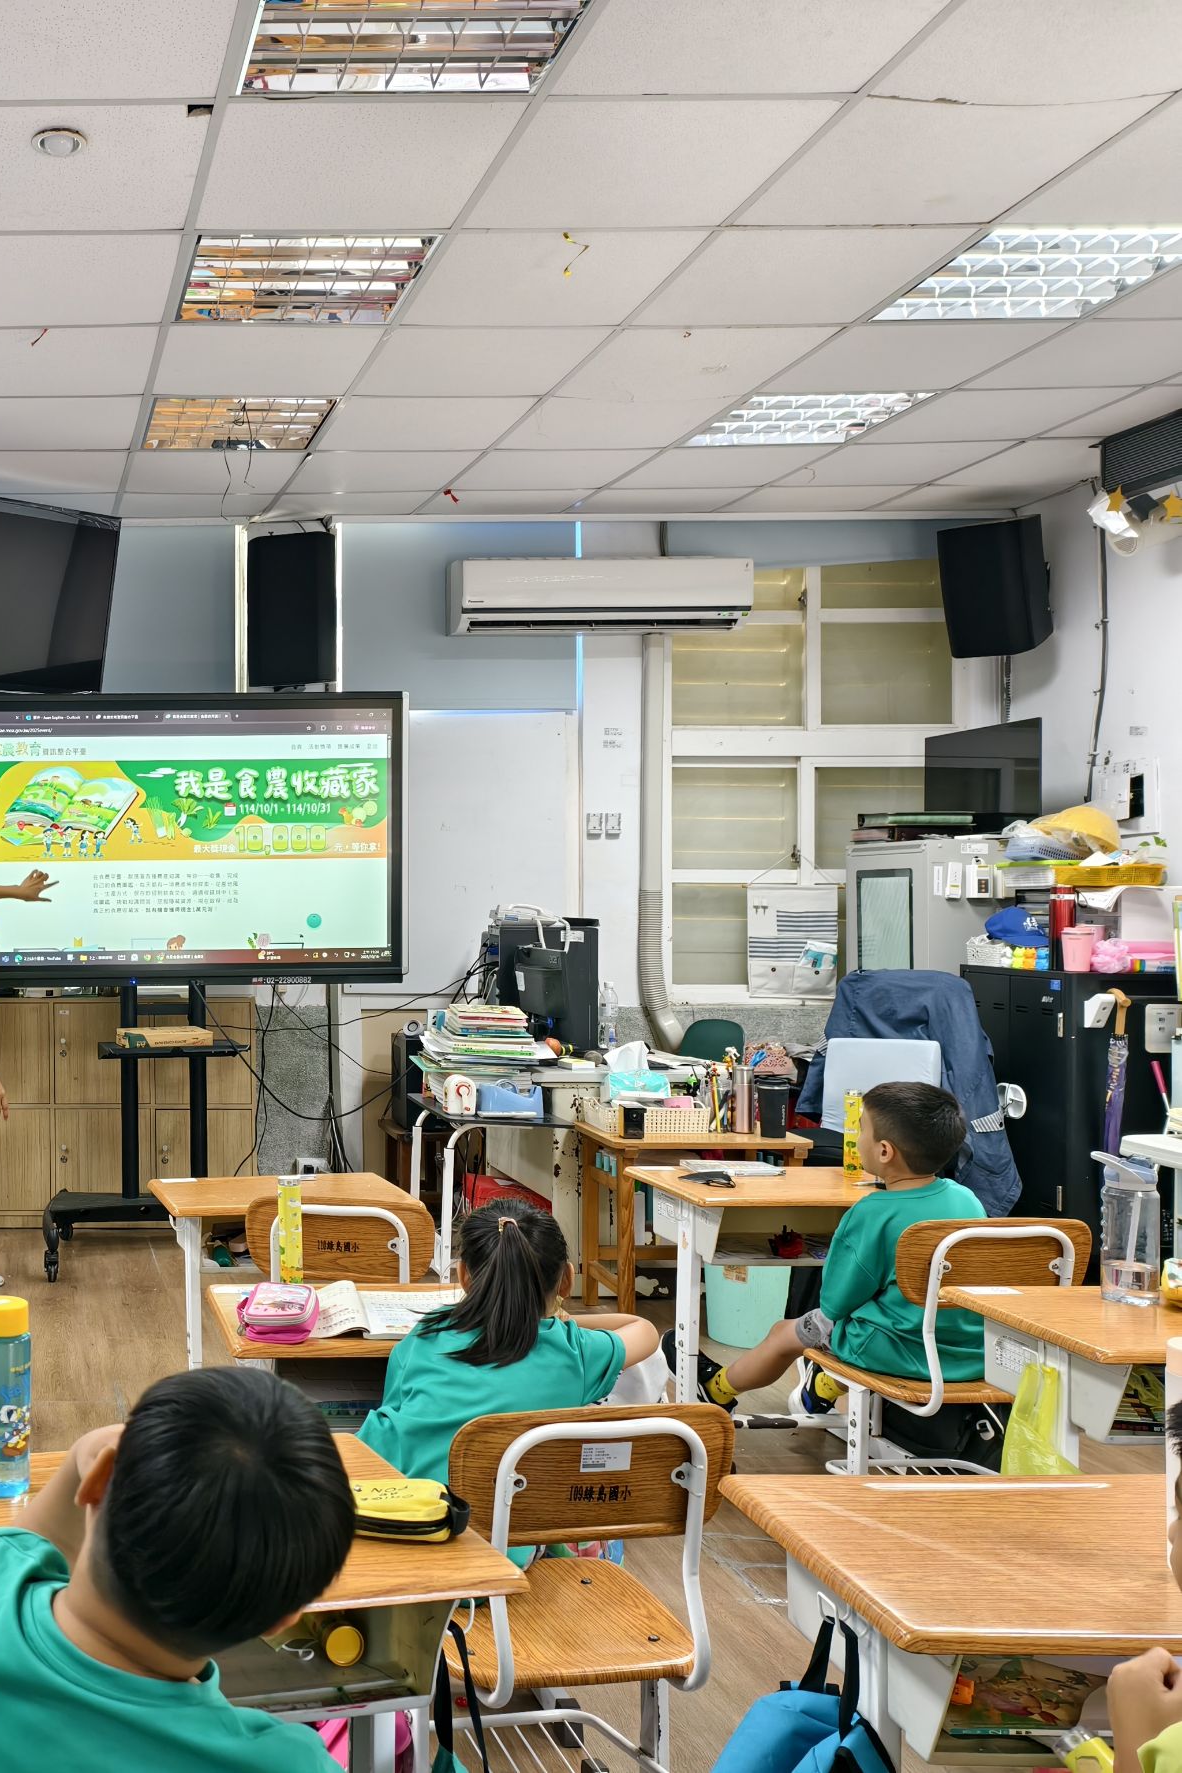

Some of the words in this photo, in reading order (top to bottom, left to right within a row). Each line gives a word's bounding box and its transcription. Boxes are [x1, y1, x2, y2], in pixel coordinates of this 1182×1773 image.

[174, 766, 380, 800] 我是食農收藏家
[239, 803, 278, 816] 114/10/1
[286, 802, 331, 815] 114/10/31
[234, 825, 328, 855] 10,000
[569, 1484, 632, 1502] 109綠島國小
